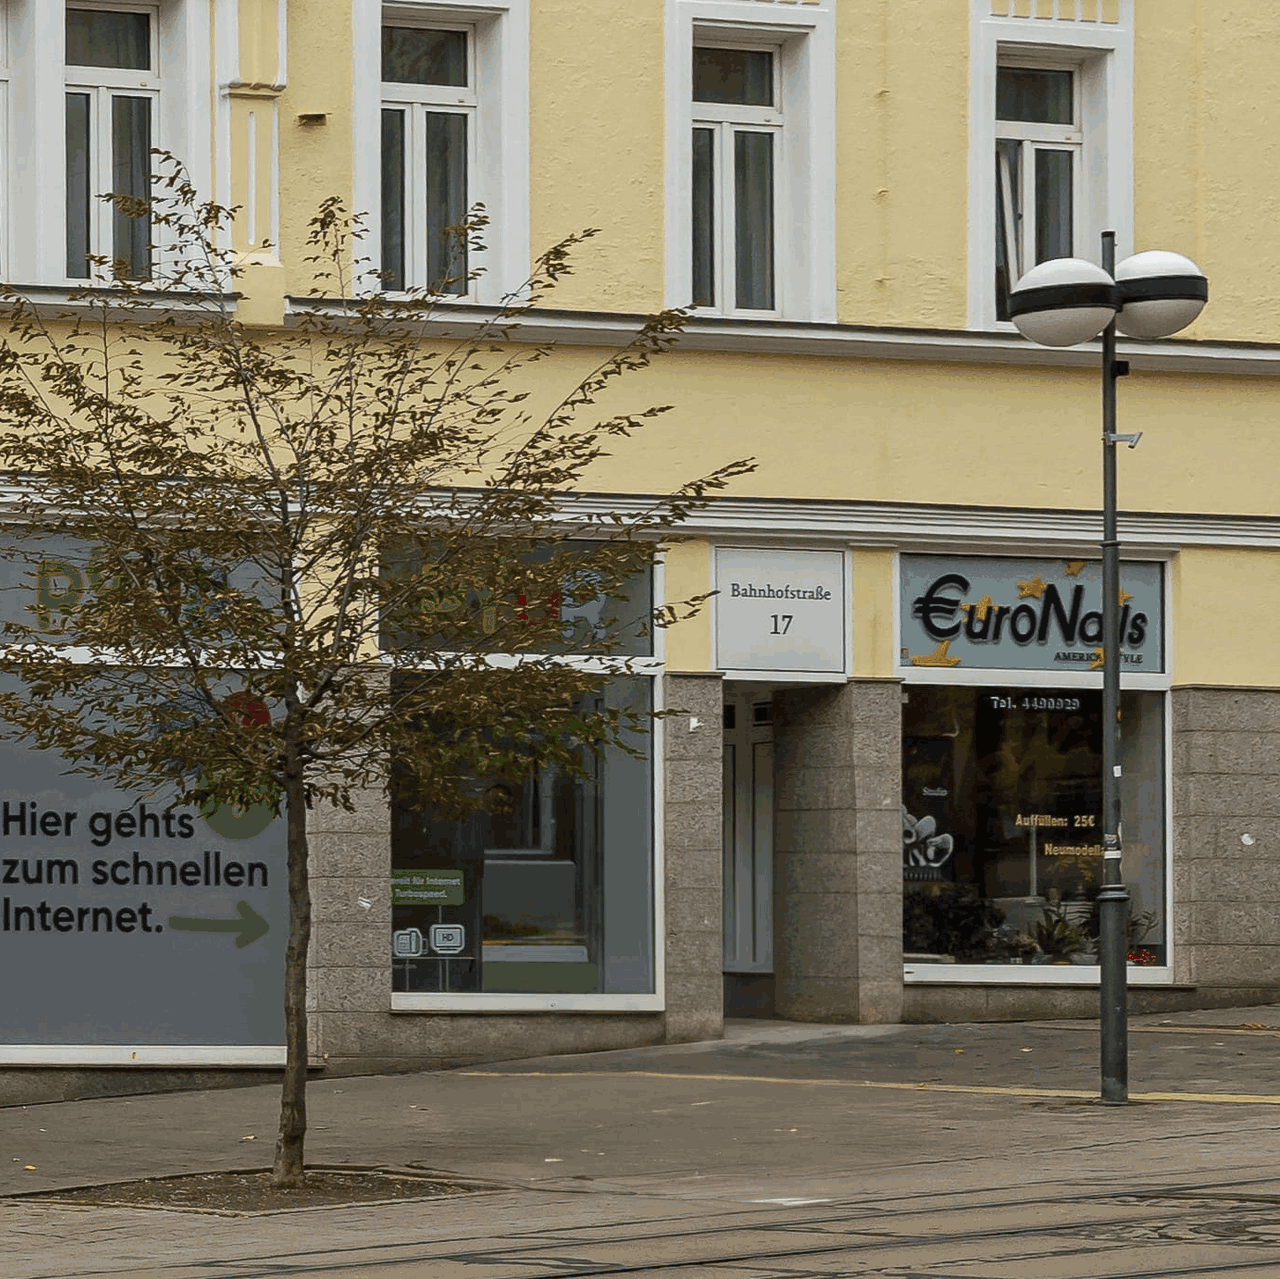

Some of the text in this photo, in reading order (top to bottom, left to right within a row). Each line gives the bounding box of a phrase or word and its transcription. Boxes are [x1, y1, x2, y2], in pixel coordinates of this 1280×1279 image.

[731, 583, 832, 601] Bahnhofstraße
[770, 615, 793, 635] 17
[990, 696, 1017, 709] Tel.
[2, 801, 195, 847] Hier gehts
[1015, 814, 1068, 827] Auffüllen:
[2, 851, 269, 887] zum schnellen
[3, 897, 164, 933] Internet.
